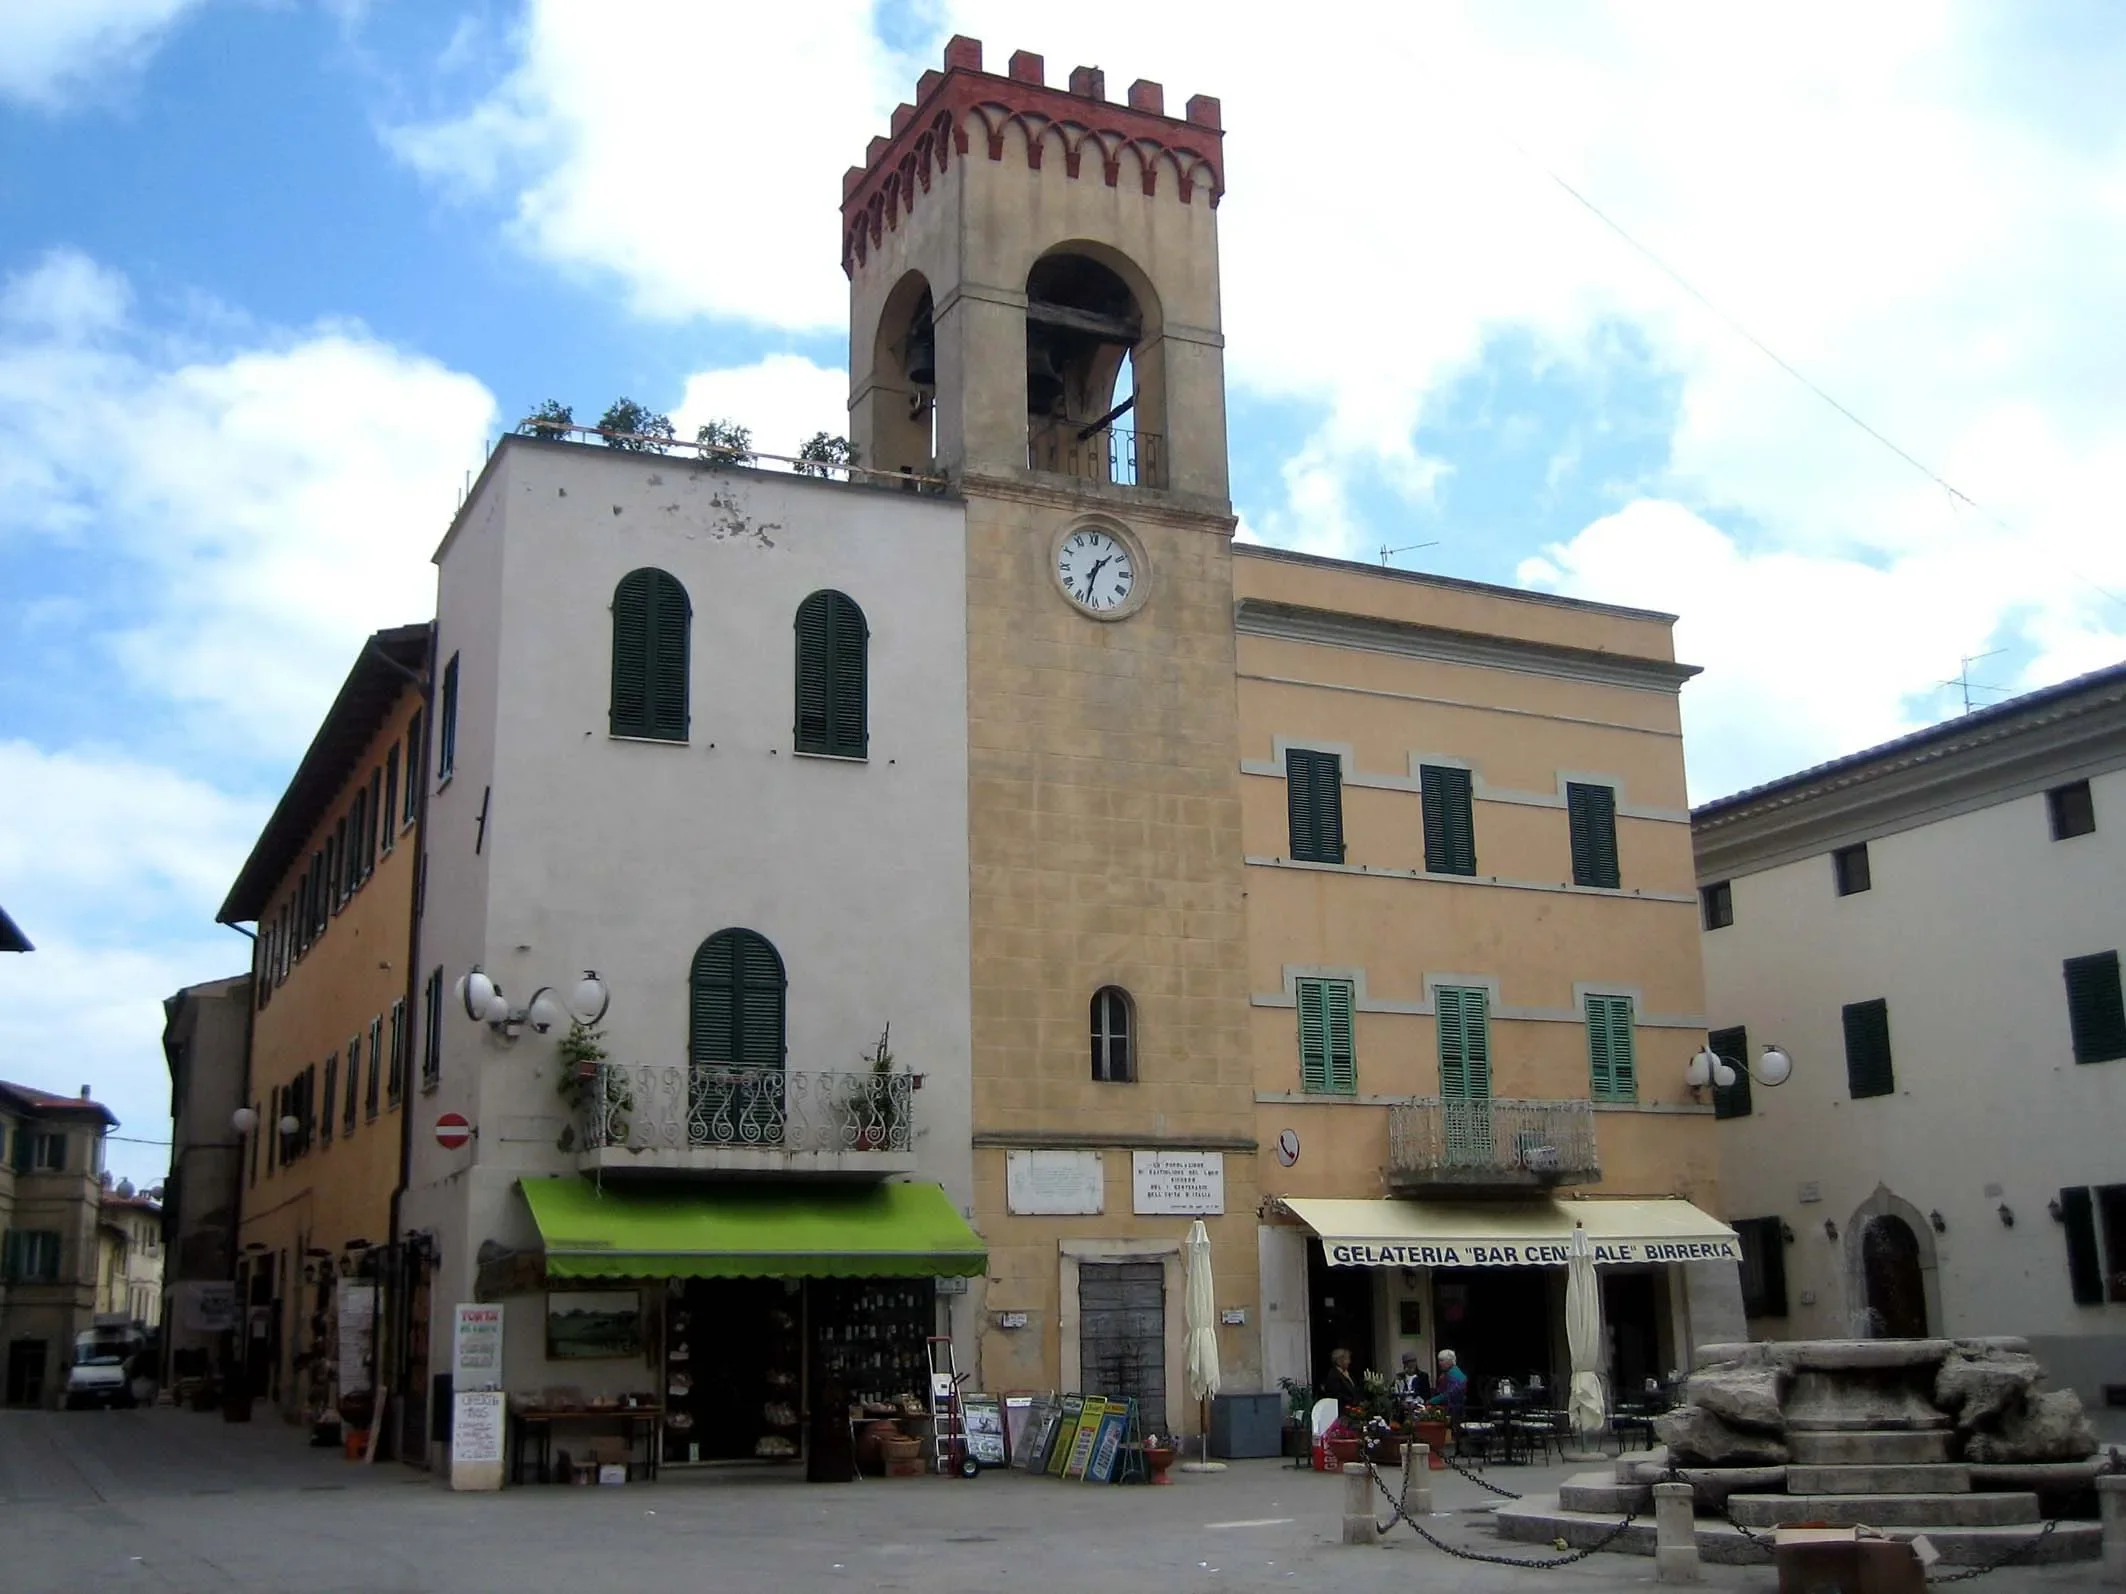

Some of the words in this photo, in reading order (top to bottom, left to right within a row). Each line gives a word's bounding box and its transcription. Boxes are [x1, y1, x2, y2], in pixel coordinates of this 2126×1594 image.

[1073, 535, 1084, 548] XI
[1089, 533, 1099, 546] XII
[1063, 545, 1075, 557] X
[1115, 555, 1125, 563] II
[1060, 562, 1071, 571] IX
[1118, 571, 1129, 579] III
[1063, 576, 1075, 589] VIII
[1075, 589, 1084, 603] VII
[1092, 596, 1099, 608] VI
[1107, 596, 1115, 606] V
[1333, 1246, 1460, 1262] GELATERIA
[1465, 1247, 1519, 1262] "BAR
[1525, 1246, 1637, 1261] CENALE"
[1644, 1243, 1735, 1259] BIRRERIA
